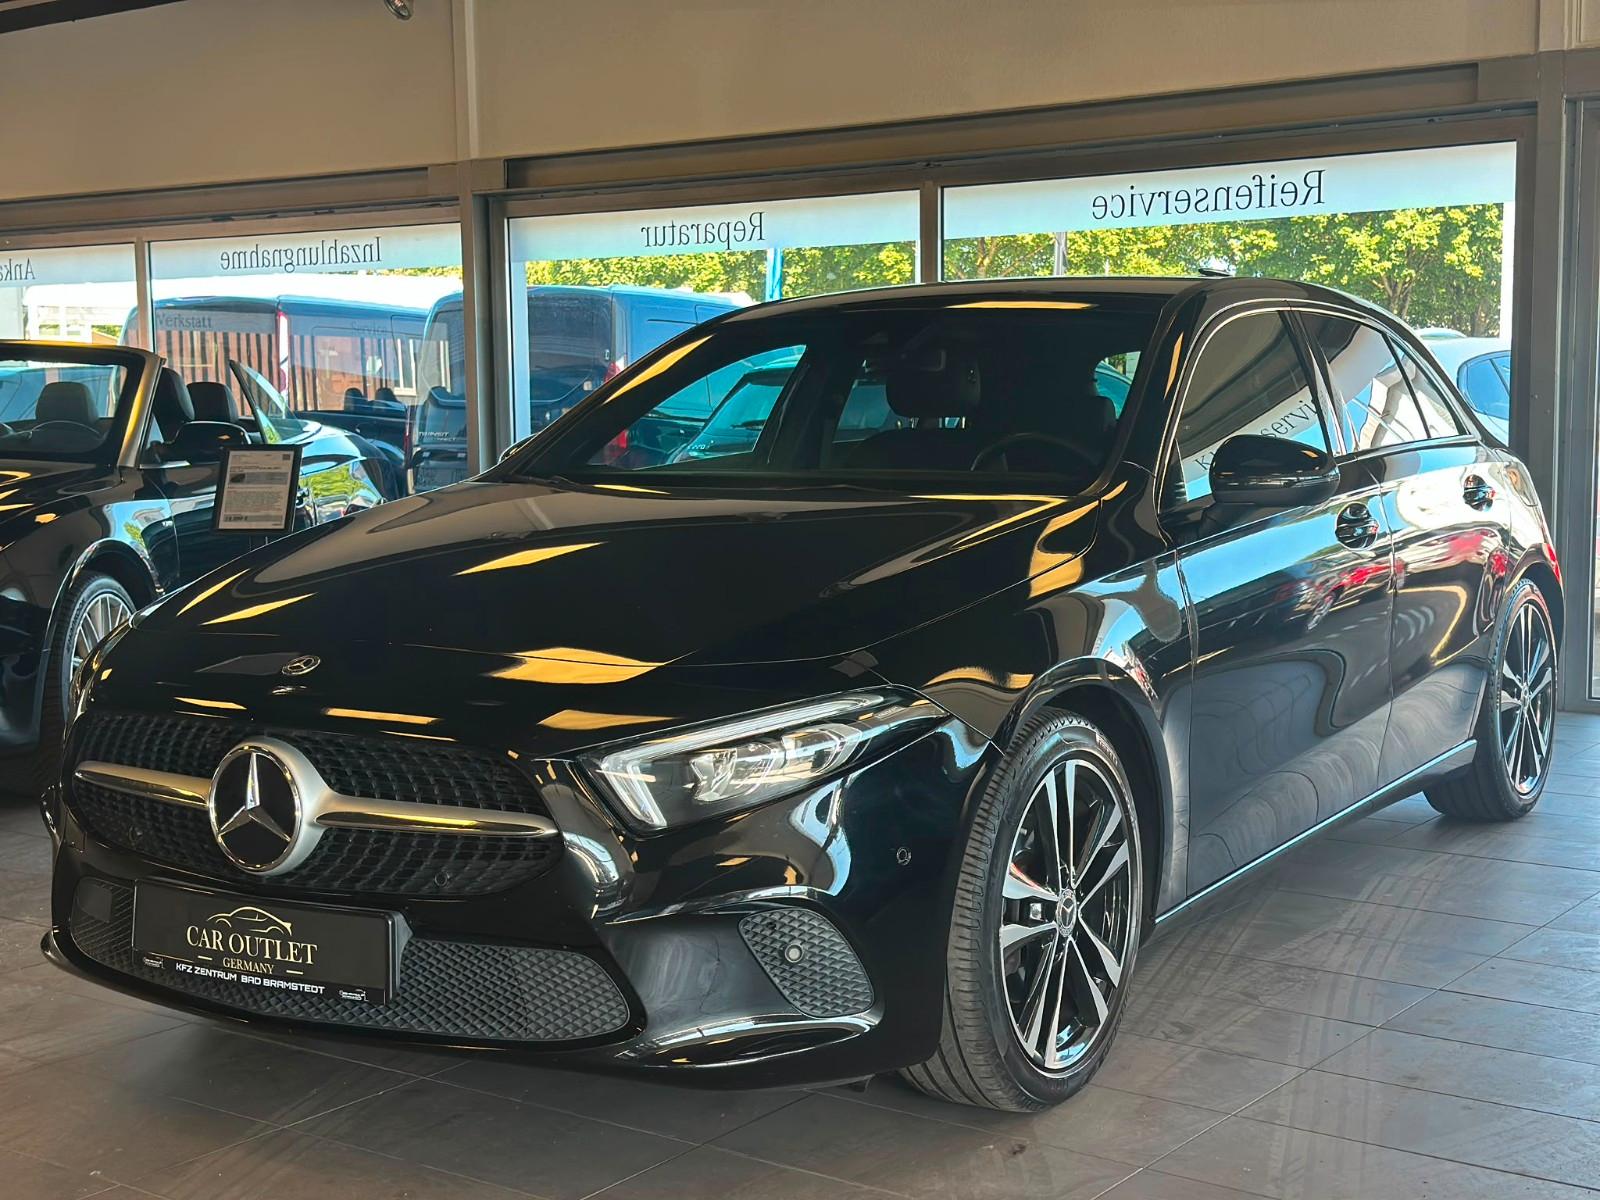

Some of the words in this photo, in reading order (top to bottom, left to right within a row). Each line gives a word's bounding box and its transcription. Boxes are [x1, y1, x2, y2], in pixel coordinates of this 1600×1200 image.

[186, 925, 224, 952] CAR
[228, 933, 318, 965] OUTLET
[175, 962, 193, 974] KFZ
[194, 966, 238, 982] ZENTRUM
[241, 974, 261, 986] BAD
[263, 978, 326, 995] BRAMSTEDT
[222, 957, 275, 976] GERMANY
